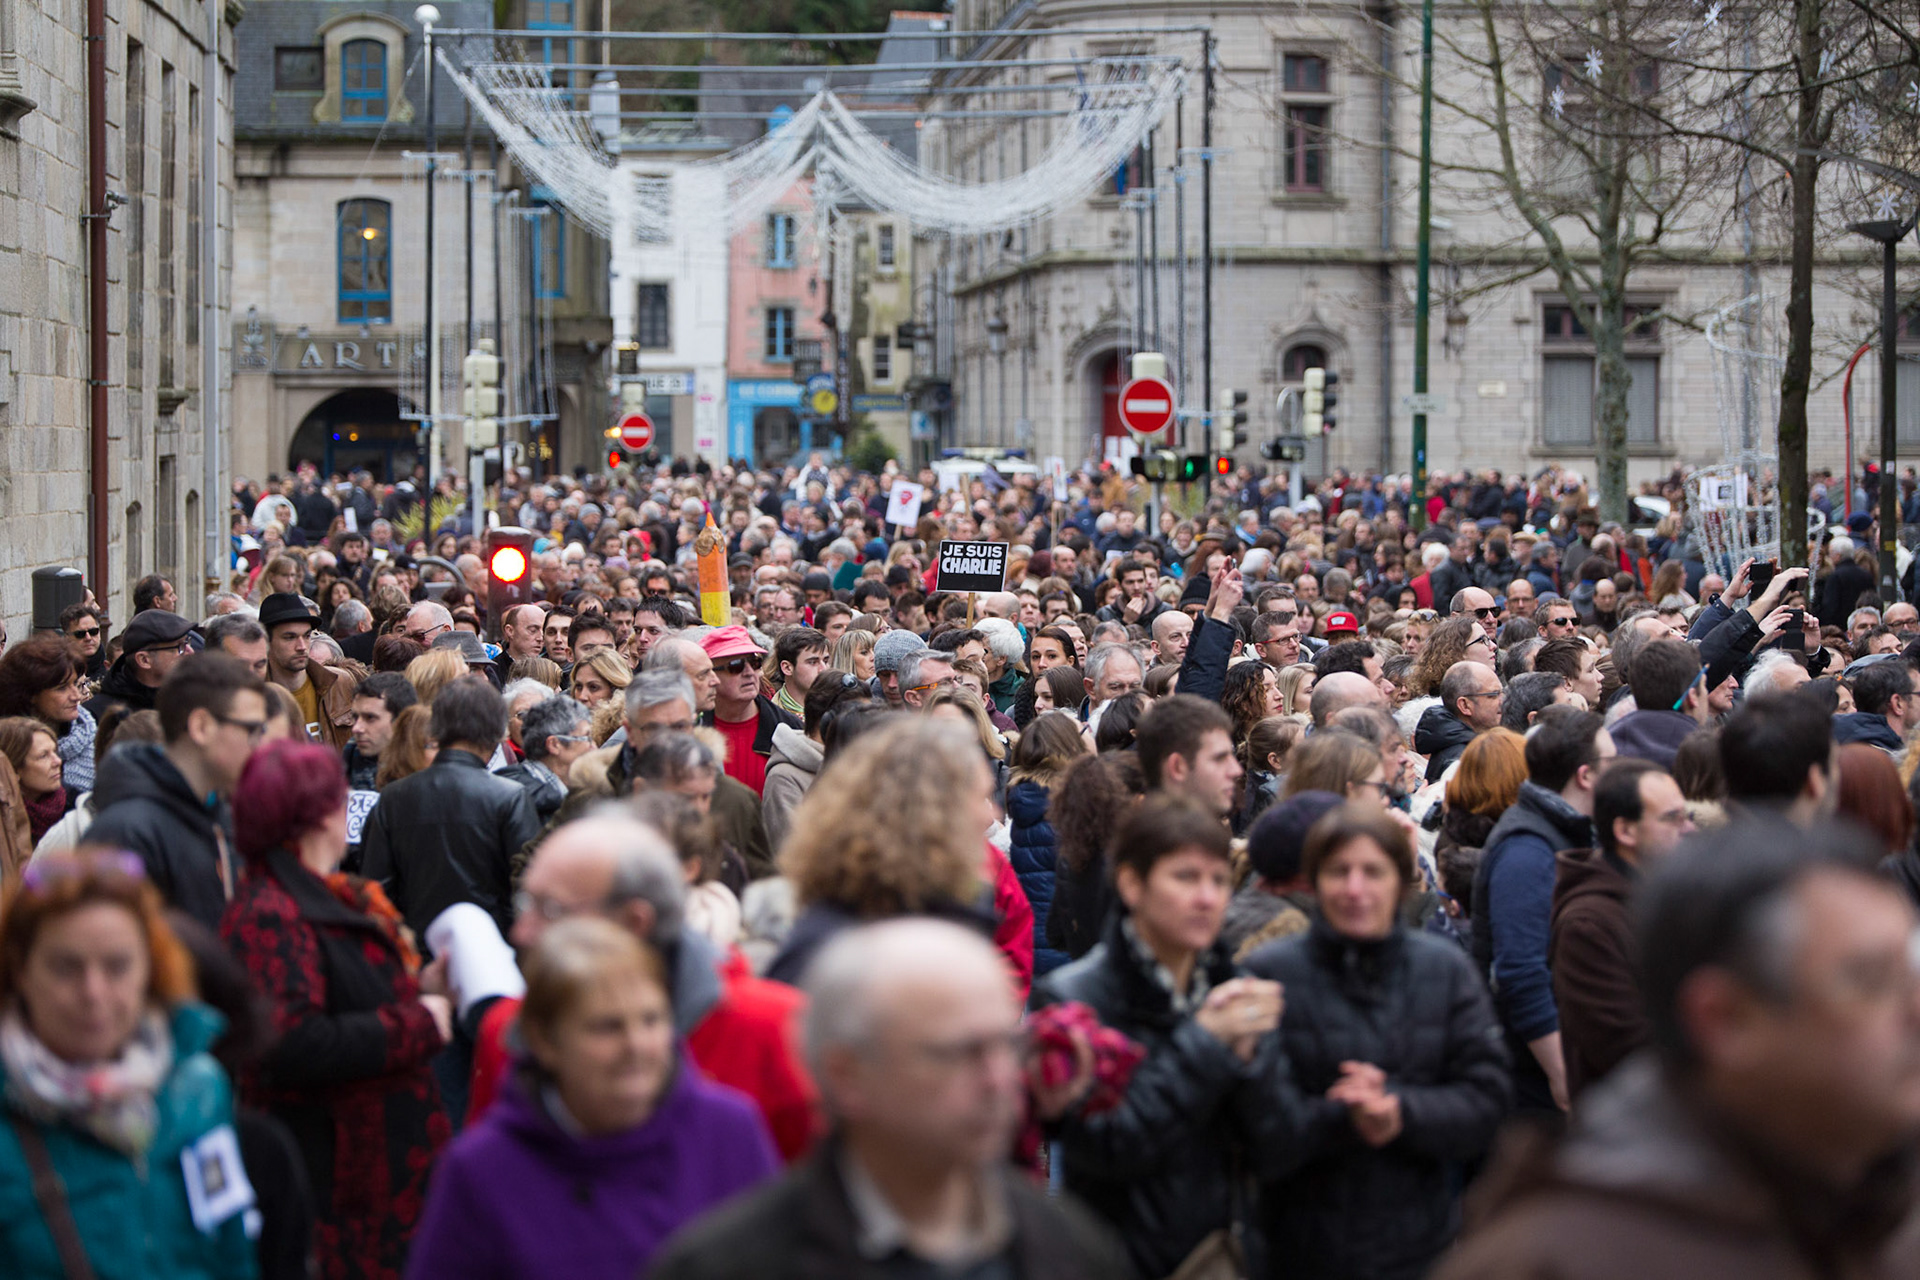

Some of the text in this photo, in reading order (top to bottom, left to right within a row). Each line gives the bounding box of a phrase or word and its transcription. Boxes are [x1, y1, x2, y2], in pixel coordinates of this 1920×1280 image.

[943, 544, 1003, 558] JE SUIS
[941, 557, 1001, 575] CHARLIE
